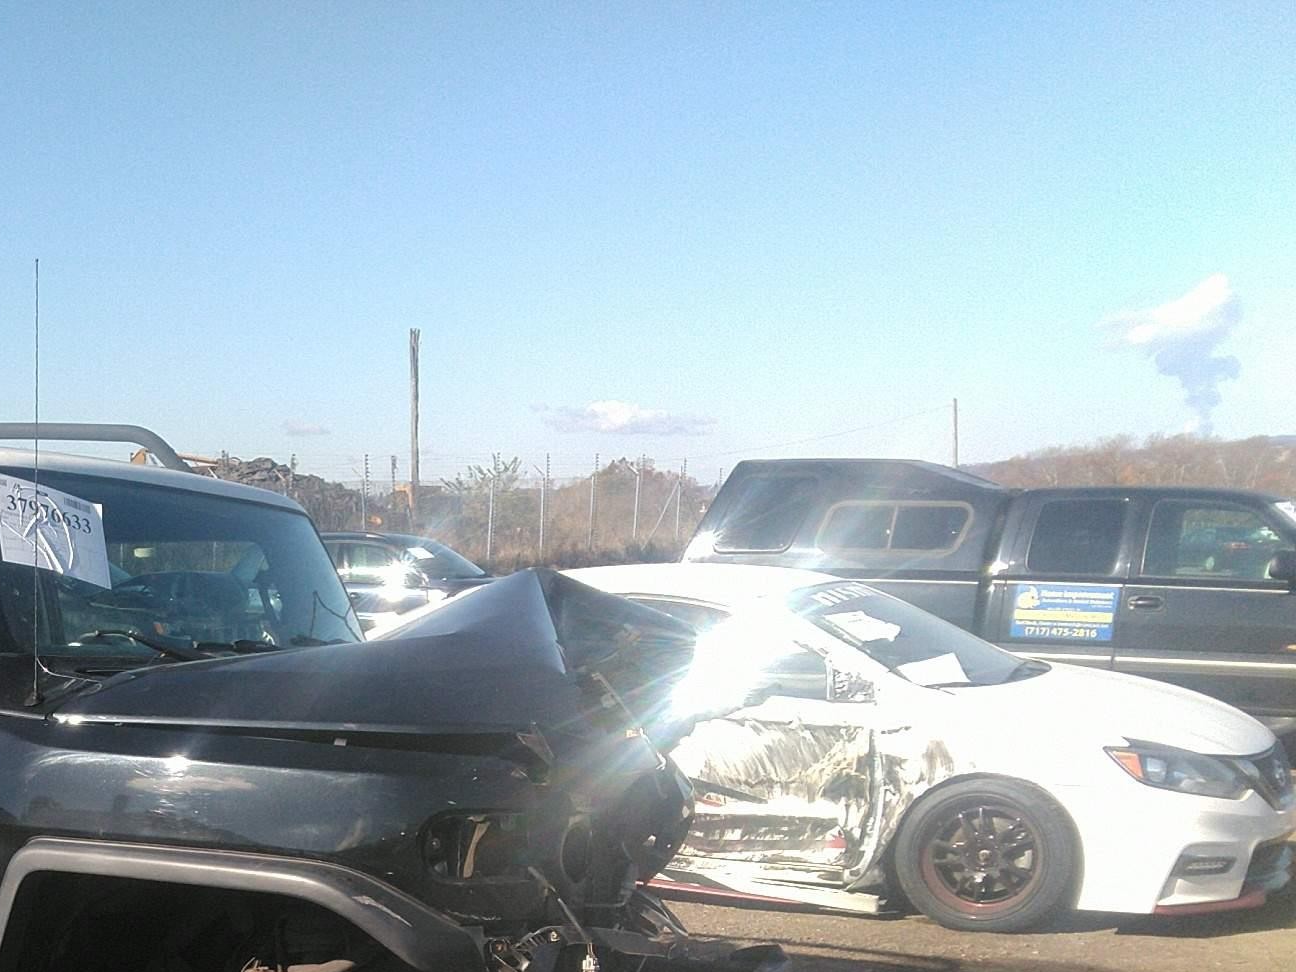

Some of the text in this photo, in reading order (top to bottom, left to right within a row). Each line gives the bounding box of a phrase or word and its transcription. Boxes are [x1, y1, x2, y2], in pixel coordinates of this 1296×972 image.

[6, 494, 92, 535] 37976633
[1025, 626, 1098, 638] (717) 475-2816
